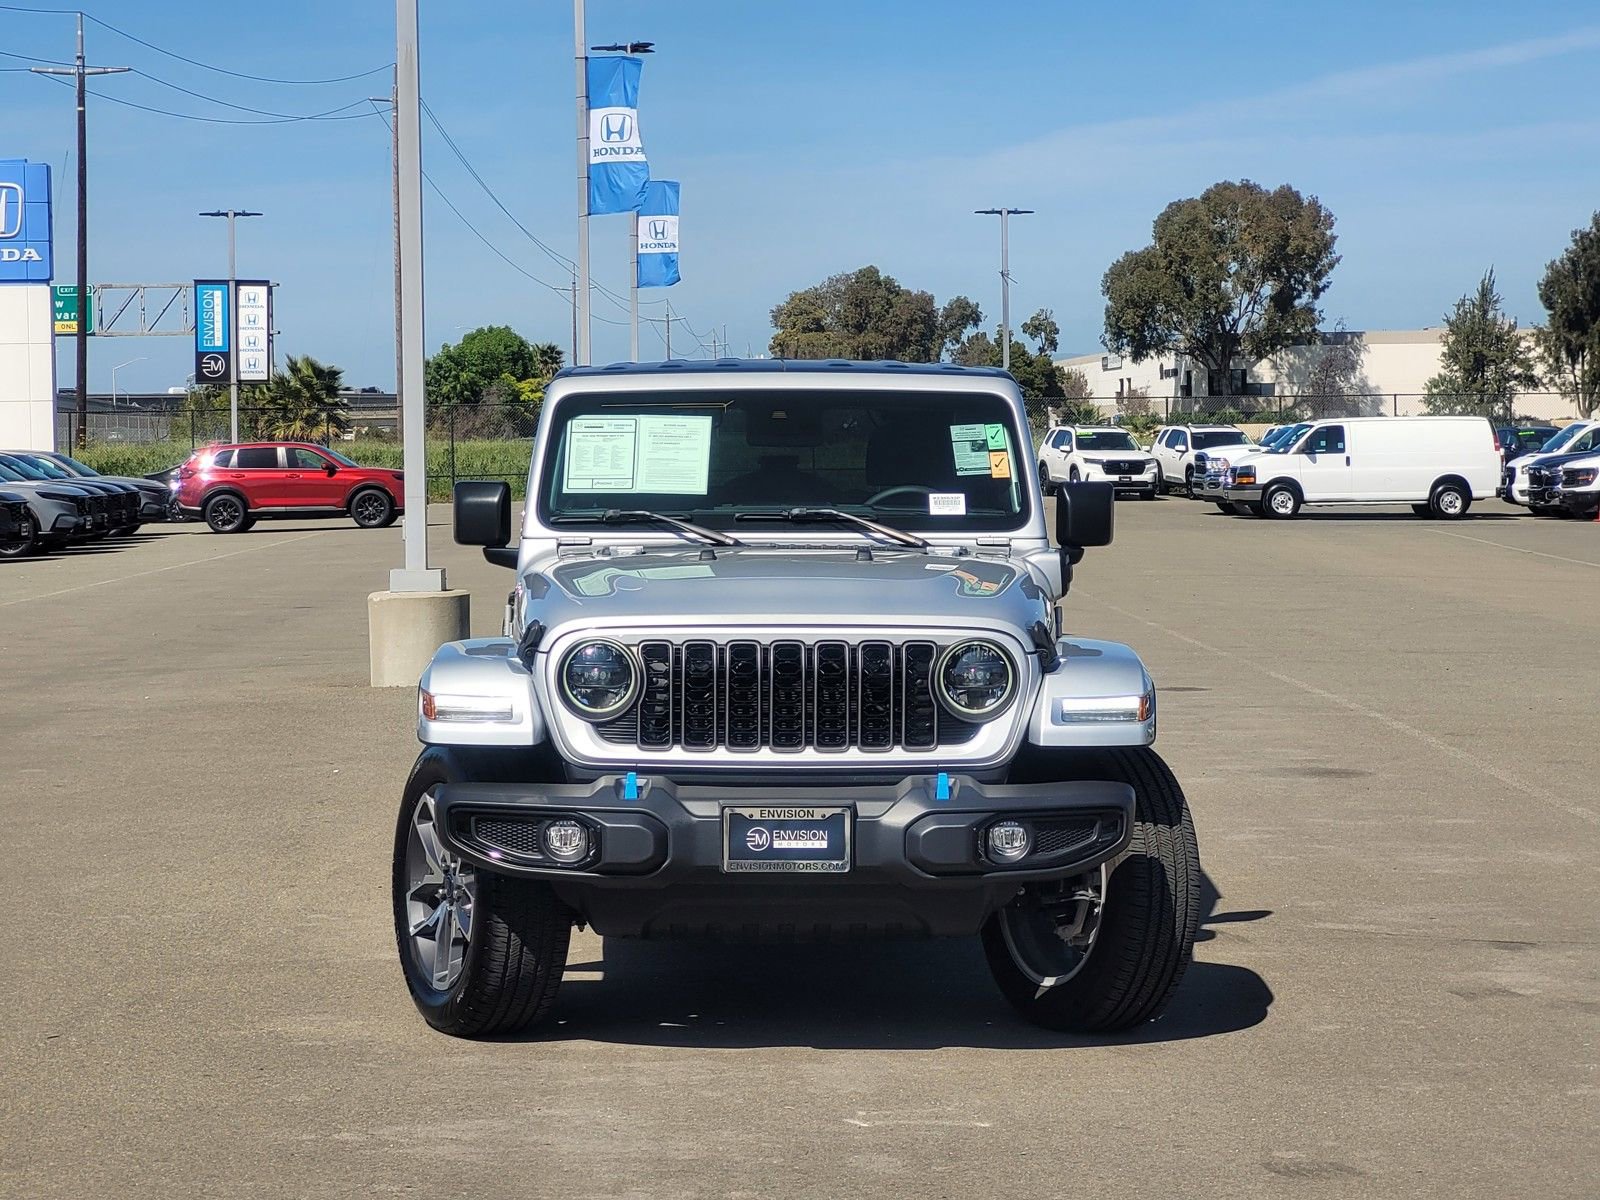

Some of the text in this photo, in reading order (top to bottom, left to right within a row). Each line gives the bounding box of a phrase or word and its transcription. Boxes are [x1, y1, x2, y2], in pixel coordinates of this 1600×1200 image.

[593, 147, 645, 157] HONDA
[56, 312, 78, 320] var
[203, 290, 214, 347] ENVISION
[759, 809, 815, 819] ENVISION
[773, 830, 828, 841] ENVISION
[729, 862, 846, 871] ENVISIONMOTORS.COM
